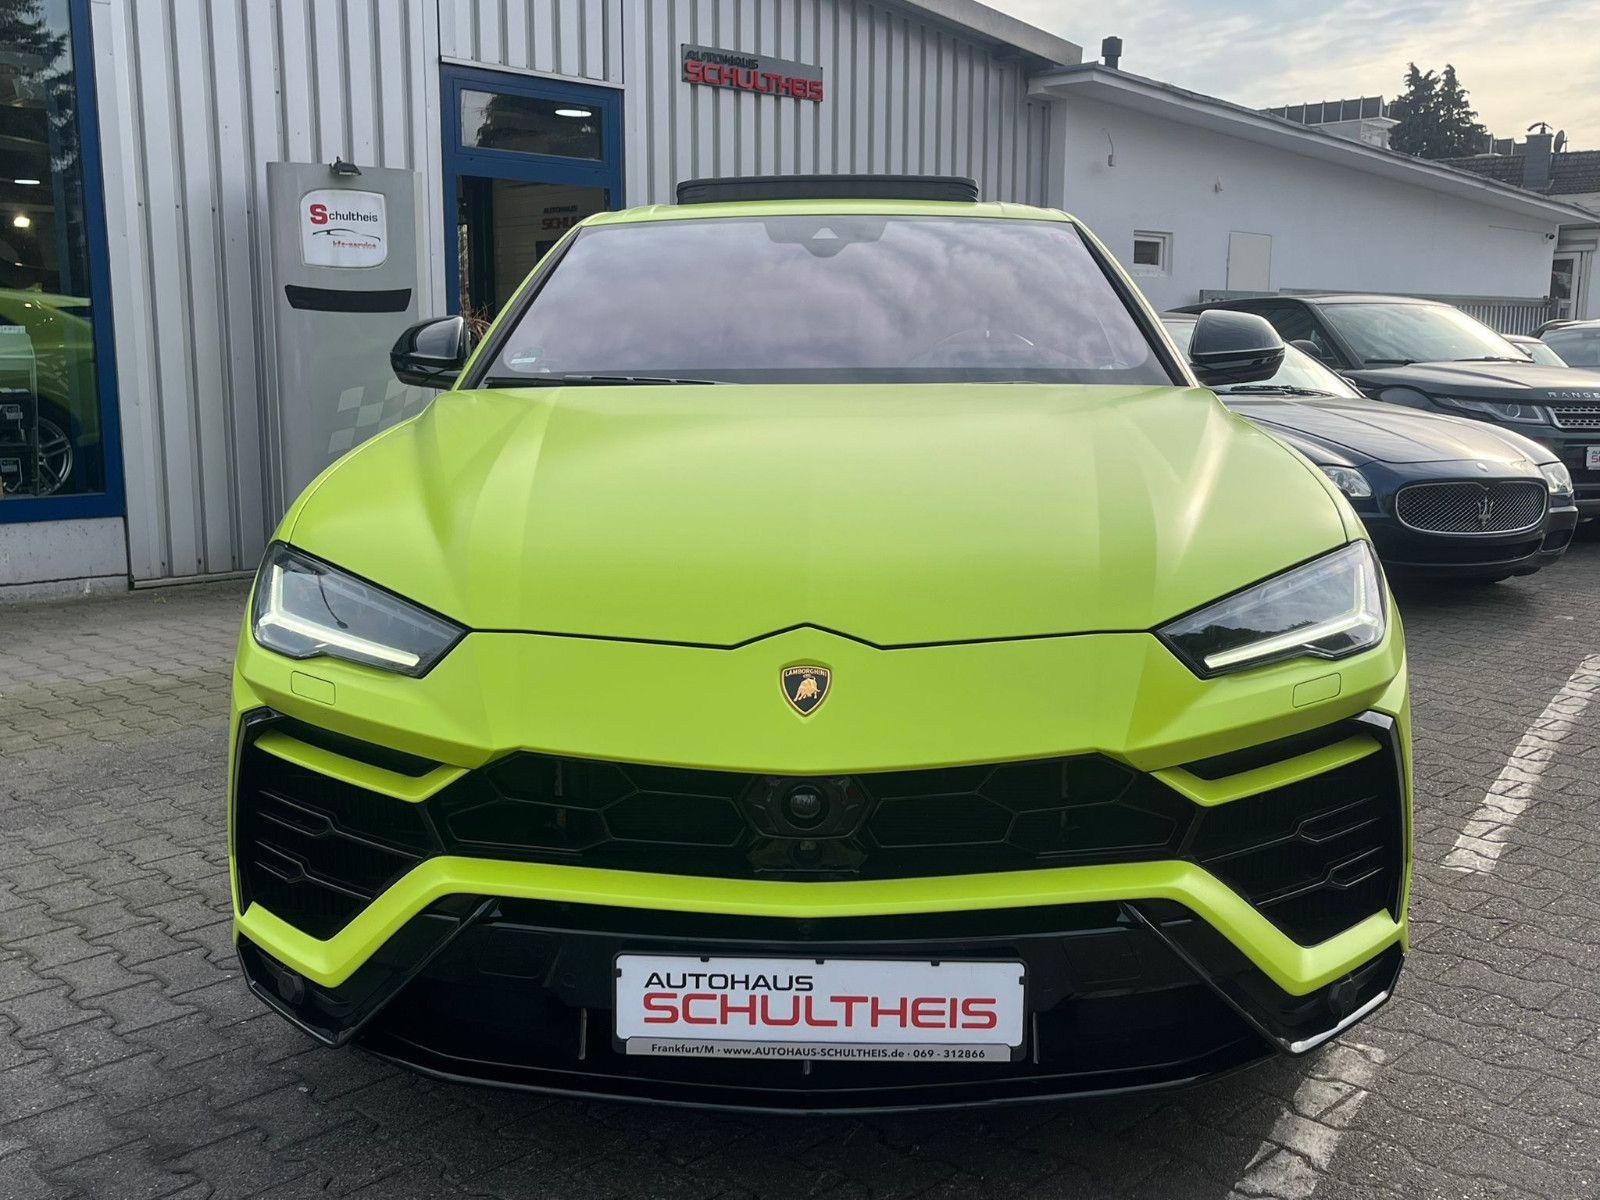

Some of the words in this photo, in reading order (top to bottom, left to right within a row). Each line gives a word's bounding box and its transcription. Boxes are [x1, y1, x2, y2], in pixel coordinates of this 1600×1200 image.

[685, 51, 759, 69] AUTOHAUS
[686, 59, 823, 100] SCHULTHEIS
[309, 203, 379, 225] Schultheis
[785, 669, 827, 677] LAMBORGHINI
[644, 972, 814, 991] AUTOHAUS
[643, 992, 998, 1030] SCHULTHEIS
[651, 1043, 715, 1055] Frankfurt/M
[723, 1046, 905, 1059] www.AUTOHAUS-SCHULTHEIS.de
[912, 1049, 935, 1058] 069
[943, 1049, 986, 1059] 312866
